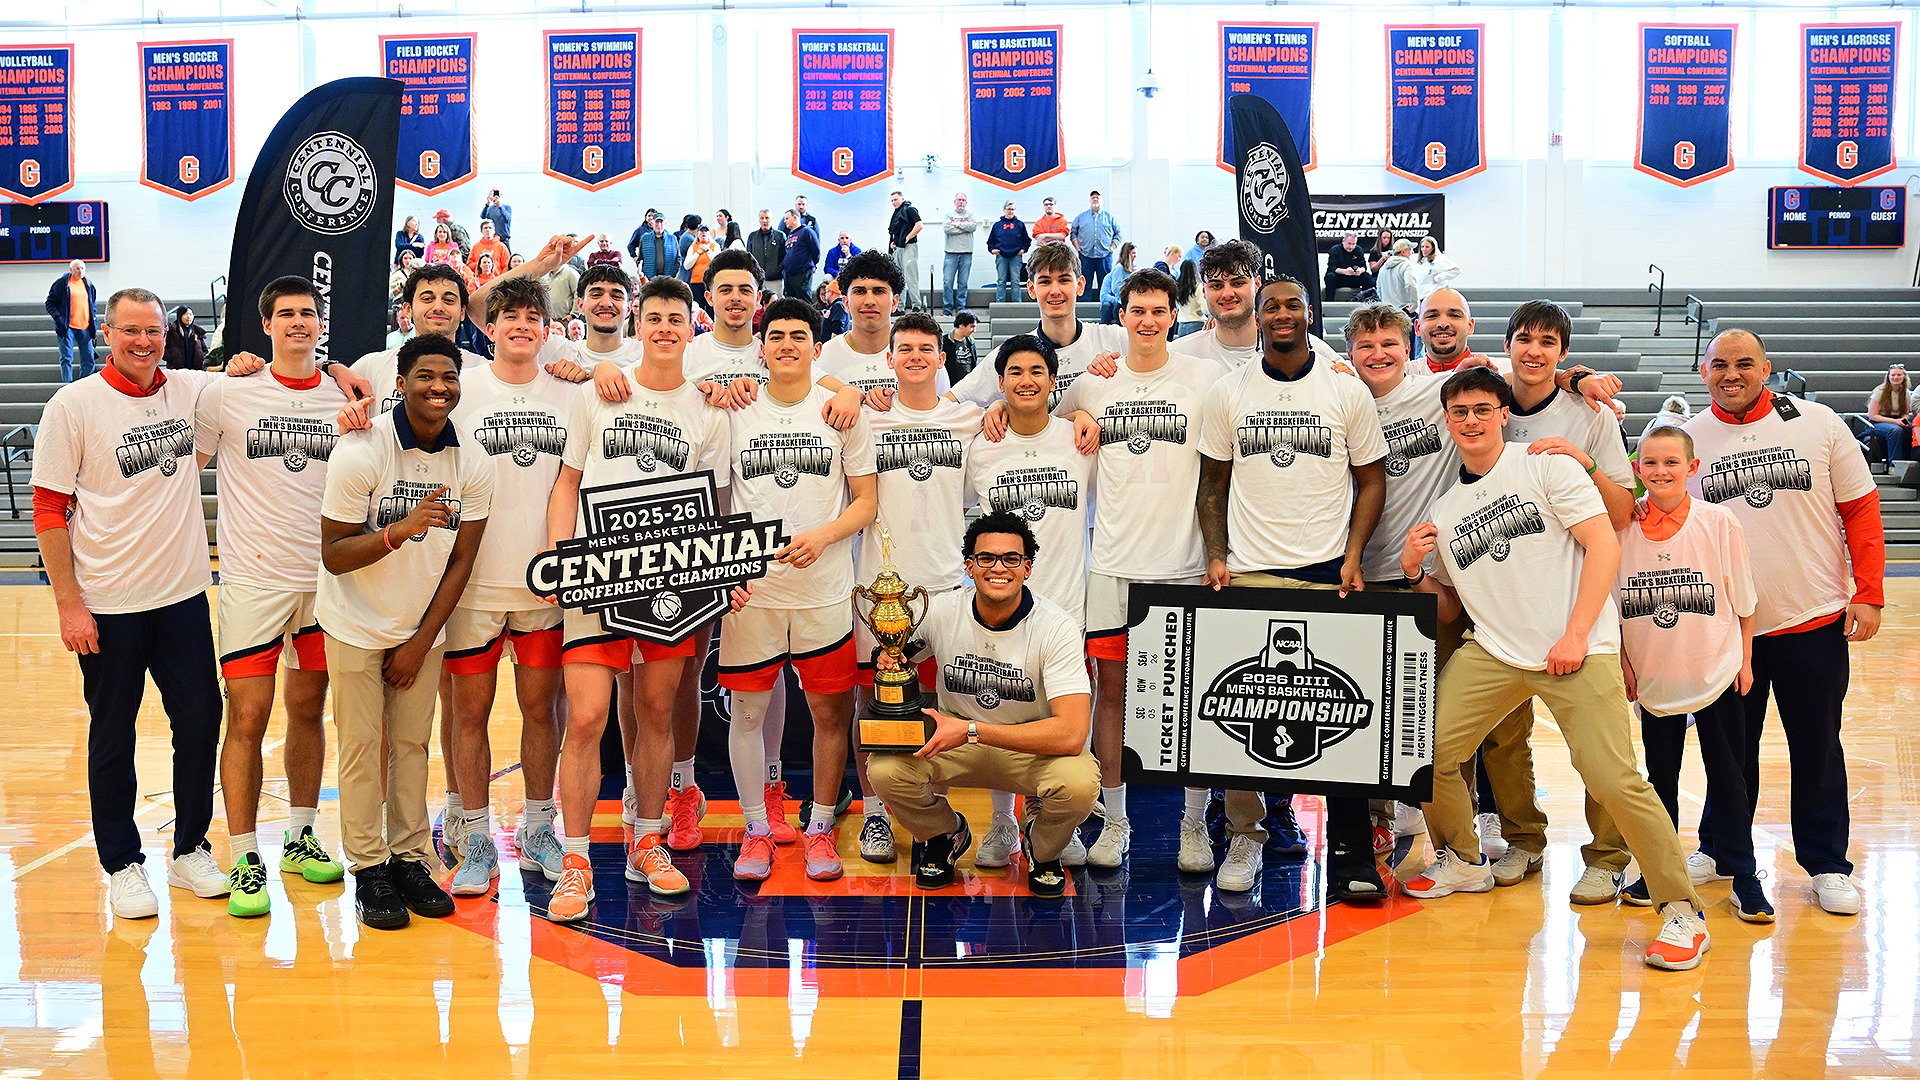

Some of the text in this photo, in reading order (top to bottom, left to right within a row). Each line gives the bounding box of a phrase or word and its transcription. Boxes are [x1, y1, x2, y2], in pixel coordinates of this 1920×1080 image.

[552, 41, 634, 52] WOMEN'S SWIMMING
[972, 37, 1052, 50] MEN'S BASKETBALL
[1228, 32, 1308, 45] WOMEN'S TENNIS
[1408, 36, 1462, 48] MEN'S GOLF
[1664, 35, 1711, 46] SOFTBALL
[1810, 34, 1890, 46] MEN'S LACROSSE
[396, 44, 460, 58] FIELD HOCKEY
[802, 42, 885, 52] WOMEN'S BASKETBALL
[1228, 46, 1308, 62] CHAMPIONS
[0, 55, 54, 67] VOLLEYBALL
[153, 51, 218, 64] MEN'S SOCCER
[554, 53, 632, 70] CHAMPIONS
[803, 54, 884, 70] CHAMPIONS
[972, 50, 1054, 68] CHAMPIONS
[1395, 49, 1474, 65] CHAMPIONS
[1648, 48, 1728, 64] CHAMPIONS
[1810, 48, 1890, 64] CHAMPIONS
[148, 64, 224, 80] CHAMPIONS
[390, 58, 467, 74] CHAMPIONS
[1228, 64, 1308, 74] CENTENNIAL CONFERENCE
[0, 68, 65, 84] HAMPIONS
[553, 71, 632, 80] CENTENNIAL CONFERENCE
[803, 72, 884, 80] CENTENNIAL CONFERENCE
[806, 90, 826, 100] 2013
[860, 90, 882, 100] 2022
[976, 88, 1025, 98] 2001 2002
[1452, 85, 1472, 95] 2002
[1704, 85, 1726, 94] 2007
[204, 100, 222, 110] 2001
[806, 102, 826, 110] 2023
[832, 102, 854, 110] 2024
[1677, 96, 1697, 105] 2021
[1704, 96, 1725, 105] 2024
[1867, 95, 1887, 104] 2001
[419, 104, 438, 114] 2001
[583, 110, 630, 121] 2003 2007
[19, 125, 38, 134] 2002
[610, 122, 630, 132] 2011
[1838, 128, 1887, 138] 2015 2016
[20, 136, 39, 146] 2005
[556, 132, 632, 144] 2012 2013 2020
[294, 138, 370, 183] CENTENNIAL
[582, 146, 604, 174] G
[832, 147, 854, 176] G
[1004, 144, 1026, 174] G
[1425, 142, 1446, 170] G
[1674, 141, 1696, 170] G
[1836, 140, 1858, 170] G
[179, 156, 200, 184] G
[420, 150, 440, 178] G
[20, 159, 40, 187] G
[292, 184, 368, 226] CONFERENCE
[1784, 188, 1800, 210] G
[1880, 188, 1896, 210] G
[78, 204, 92, 224] G
[1312, 211, 1432, 228] CENTENNIAL
[1784, 212, 1806, 221] HOME
[1871, 212, 1896, 220] GUEST
[70, 226, 95, 235] GUEST
[1132, 406, 1172, 414] BASKETBALL
[264, 422, 328, 434] MEN'S BASKETBALL
[488, 418, 552, 426] MEN'S BASKETBALL
[620, 420, 677, 437] MEN'S BASKETBALL
[1097, 414, 1187, 446] CHAMPIONS
[1250, 418, 1271, 426] MEN'S
[474, 426, 567, 456] CHAMPIONS
[754, 438, 818, 448] MEN'S BASKETBALL
[908, 432, 948, 441] BASKETBALL
[1237, 426, 1332, 458] CHAMPIONS
[603, 428, 690, 472] CHAMPIONS
[876, 440, 962, 473] CHAMPIONS
[741, 447, 832, 480] CHAMPIONS
[1716, 460, 1739, 472] MEN'S
[1742, 450, 1790, 466] BASKETBALL
[1001, 472, 1063, 484] MEN'S BASKETBALL
[1701, 459, 1812, 504] CHAMPIONS
[989, 480, 1078, 512] CHAMPIONS
[610, 502, 696, 531] 2025-26
[1459, 519, 1478, 534] MEN'S
[1479, 498, 1516, 524] BASKETBALL
[588, 520, 722, 548] MEN'S BASKETBALL
[1450, 502, 1545, 570] CHAMPIONS
[532, 526, 785, 592] CENTENNIAL
[562, 560, 762, 604] CONFERENCE CHAMPIONS
[1632, 574, 1698, 587] MEN'S BASKETBALL
[1620, 584, 1716, 620] CHAMPIONS
[1276, 640, 1300, 648] NCAA
[1150, 654, 1158, 664] 26
[958, 658, 978, 670] MEN'S
[980, 664, 1018, 678] BASKETBALL
[944, 664, 1036, 702] CHAMPIONS
[1136, 650, 1148, 719] SEC ROW SEAT
[1149, 682, 1156, 690] 01
[1242, 673, 1330, 686] 2026 DIII
[1160, 612, 1178, 766] TICKET PUNCHED
[1226, 684, 1346, 699] MEN'S BASKETBALL
[1202, 696, 1368, 724] CHAMPIONSHIP
[1418, 652, 1428, 758] #IGNITINGGREATNESS
